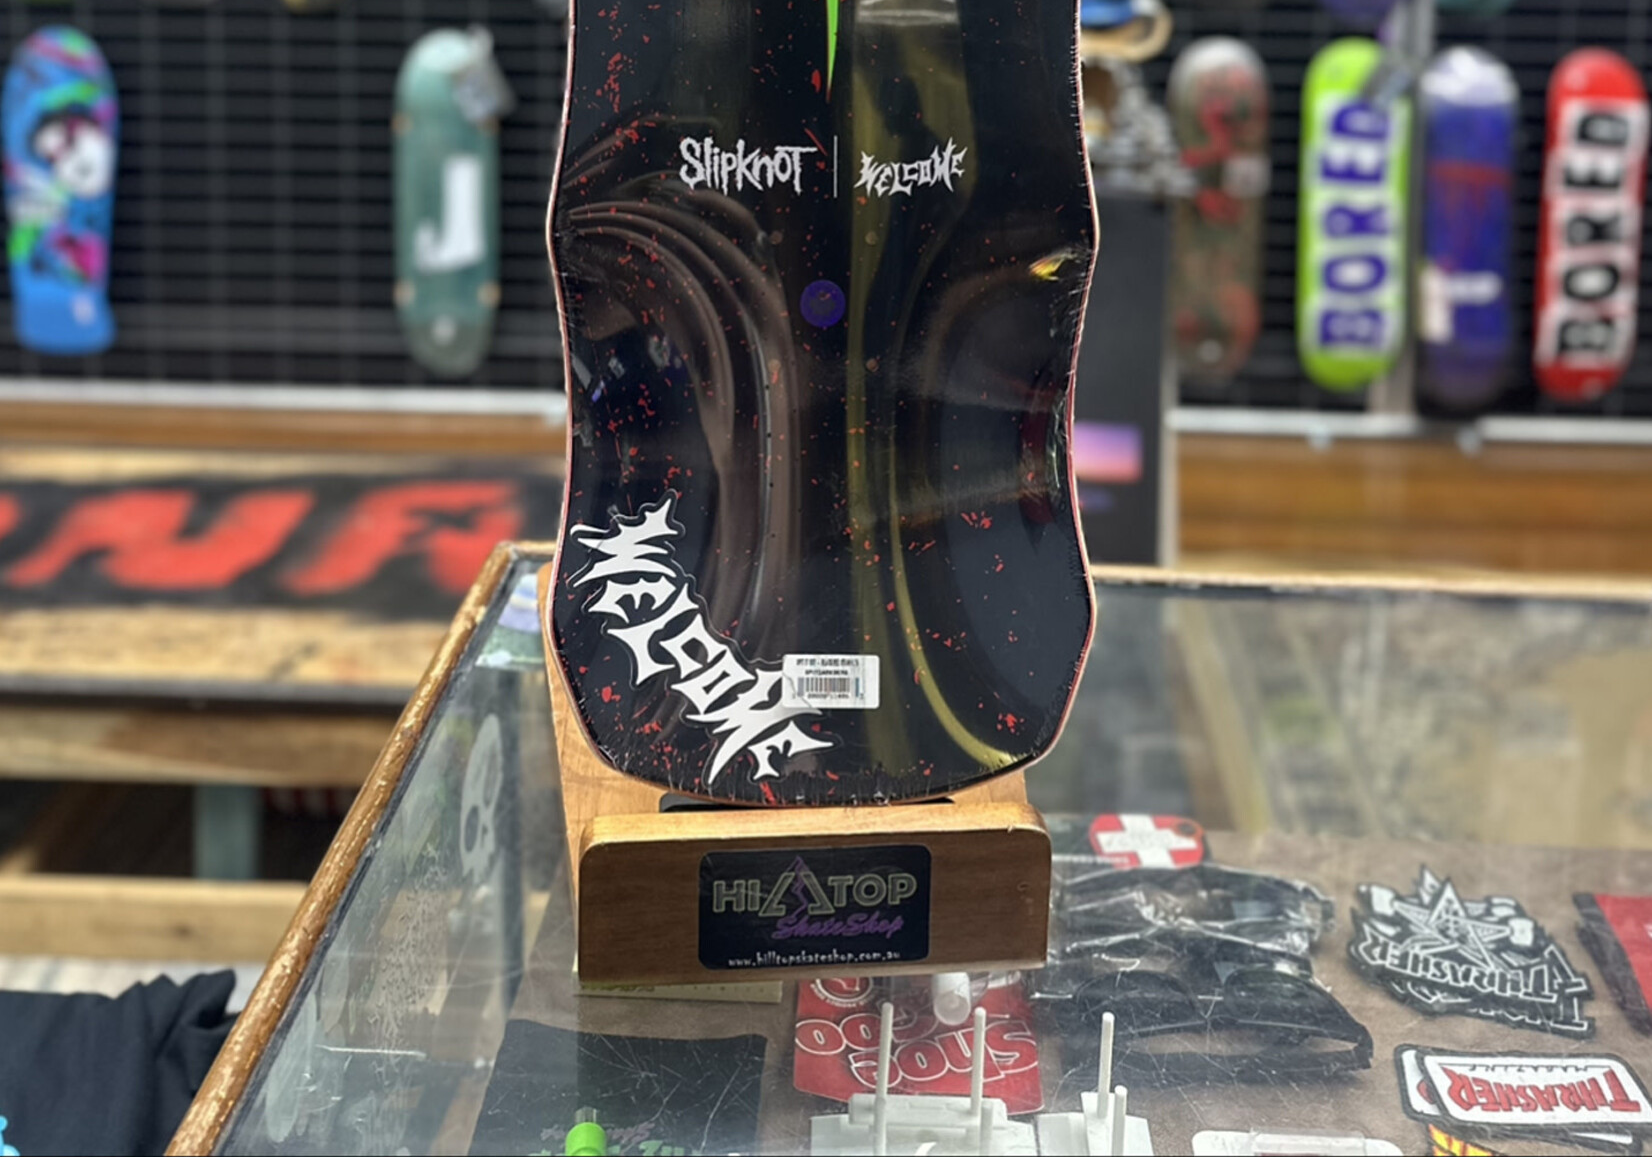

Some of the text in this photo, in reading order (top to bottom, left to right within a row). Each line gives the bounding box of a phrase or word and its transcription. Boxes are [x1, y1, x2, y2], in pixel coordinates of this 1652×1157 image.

[854, 137, 968, 197] WELCOME
[1319, 102, 1391, 348] BORED
[1557, 112, 1630, 355] BORED
[573, 498, 834, 785] WELCOME
[727, 948, 901, 967] www.hilltopskateshop.com.au
[1358, 921, 1558, 1003] THRASHER
[1440, 1065, 1642, 1112] THRASHER
